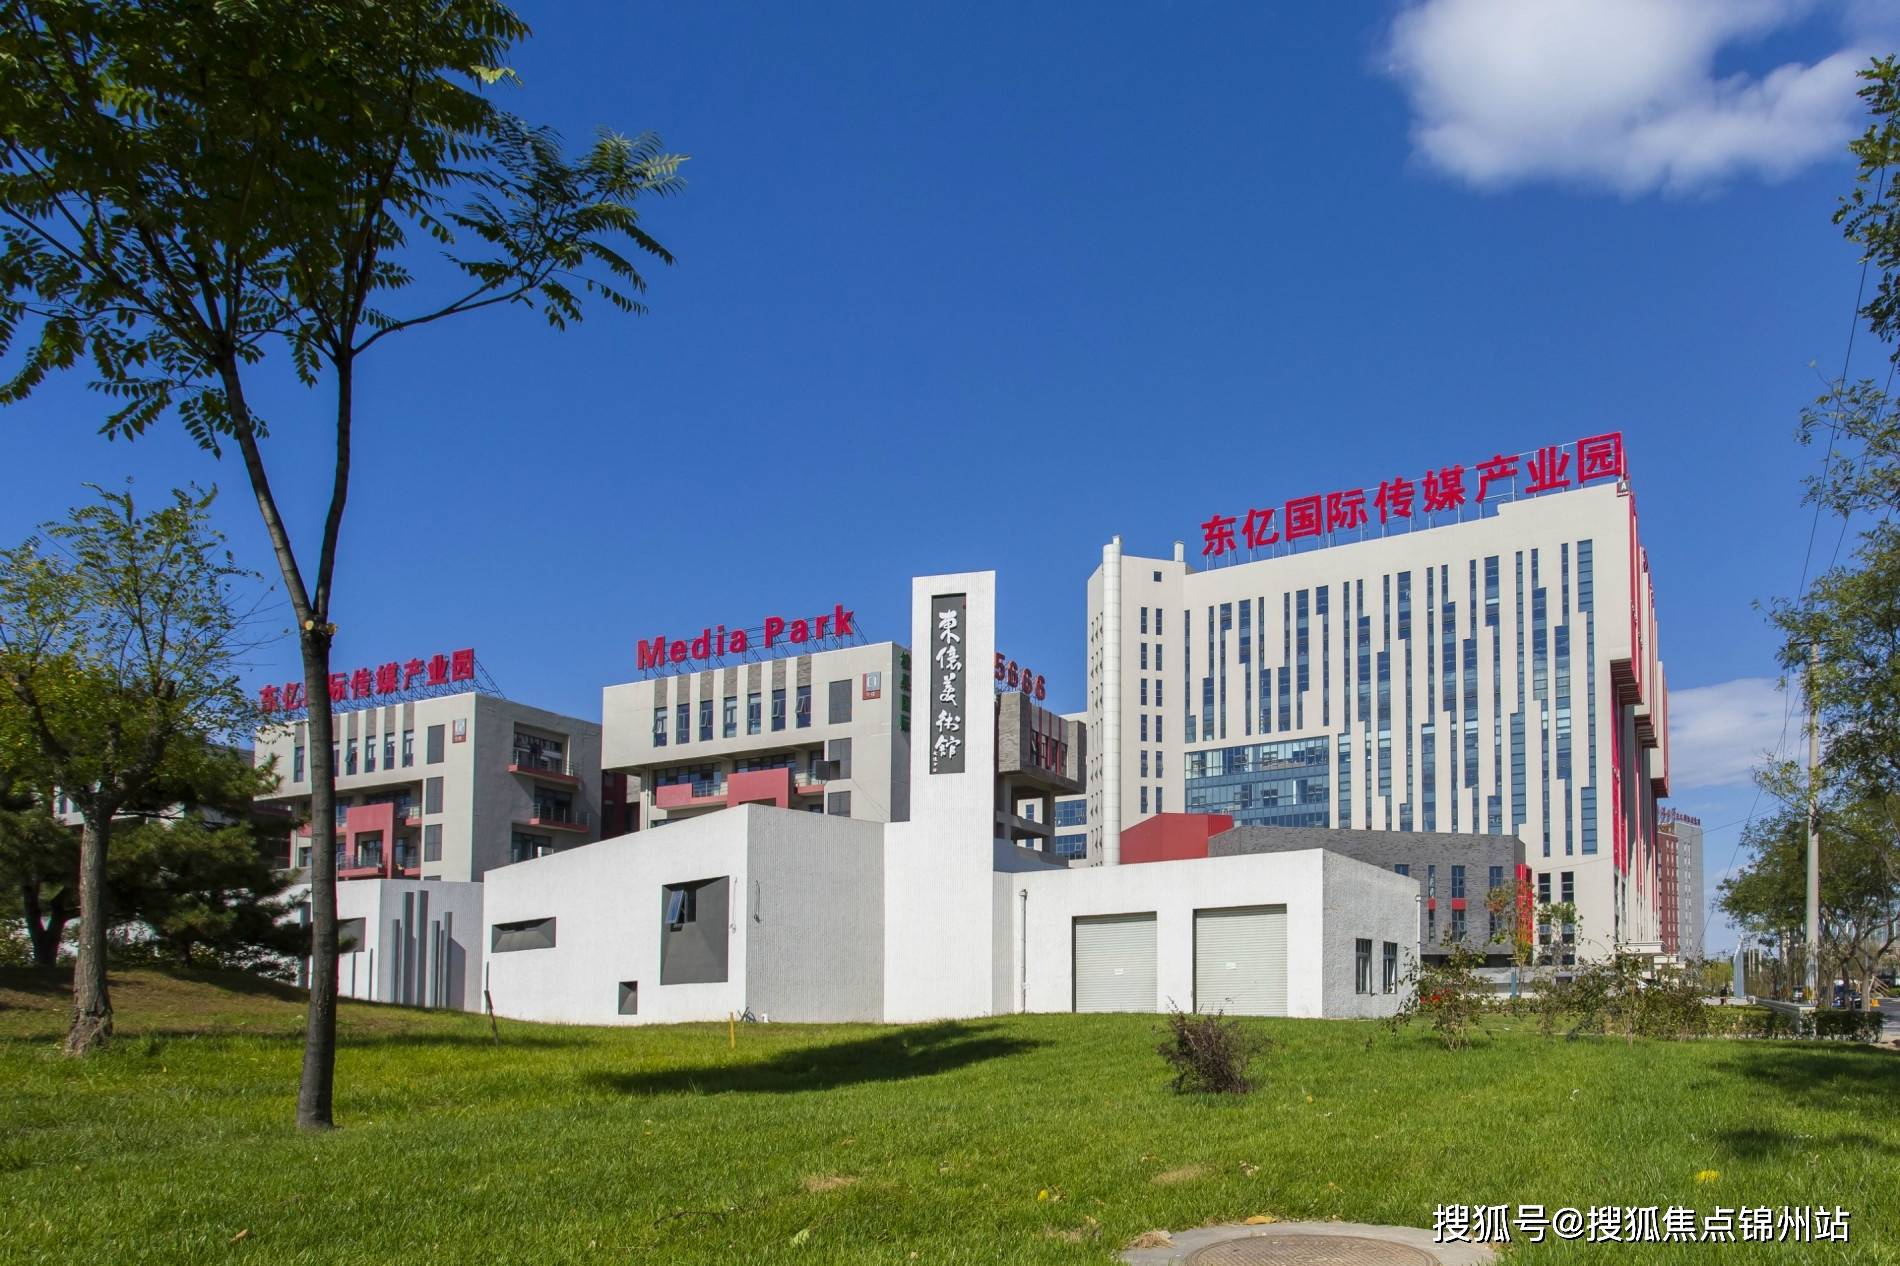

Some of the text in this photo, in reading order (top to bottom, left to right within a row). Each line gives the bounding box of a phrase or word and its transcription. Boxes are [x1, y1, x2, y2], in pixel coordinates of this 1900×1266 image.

[1201, 432, 1623, 556] 东亿国际传媒产业园
[637, 603, 855, 670] Media Park
[260, 648, 474, 712] 东亿际传媒产业园
